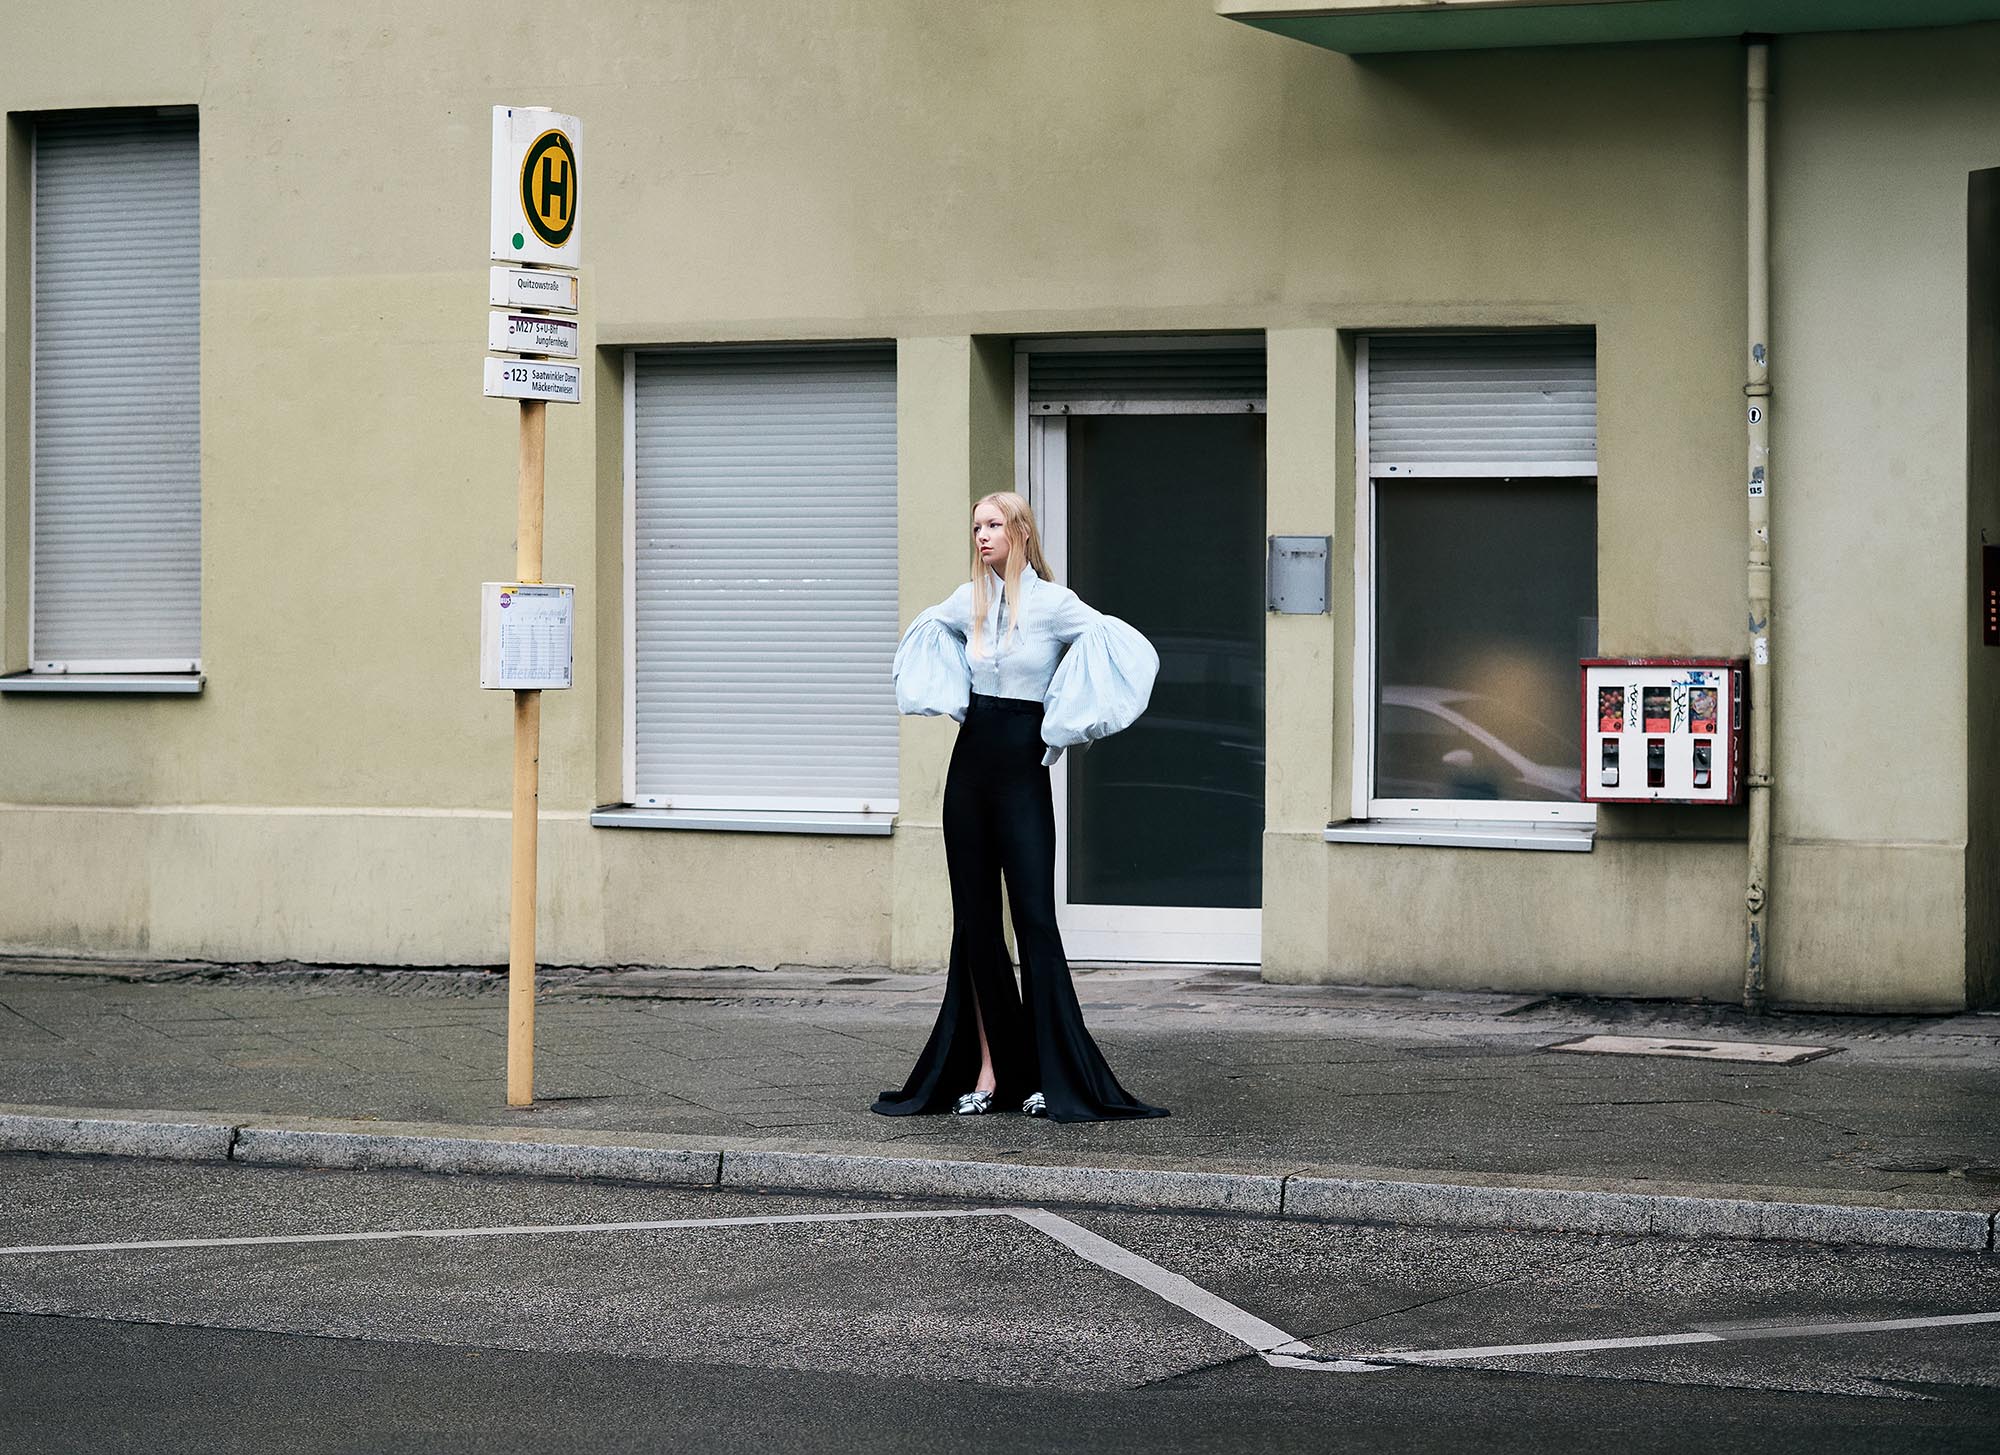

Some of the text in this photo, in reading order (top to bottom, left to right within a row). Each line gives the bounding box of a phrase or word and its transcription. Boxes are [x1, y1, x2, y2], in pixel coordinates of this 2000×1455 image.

[541, 156, 568, 221] H
[517, 278, 559, 291] Quitzowstraße
[516, 320, 533, 333] M27
[536, 323, 558, 334] S+U-Bhf
[536, 335, 568, 348] Jungfernheide
[511, 368, 527, 382] 123
[532, 369, 564, 381] Saatwinkler
[565, 372, 577, 383] Damm
[532, 381, 573, 394] Mäckeritzwiesen
